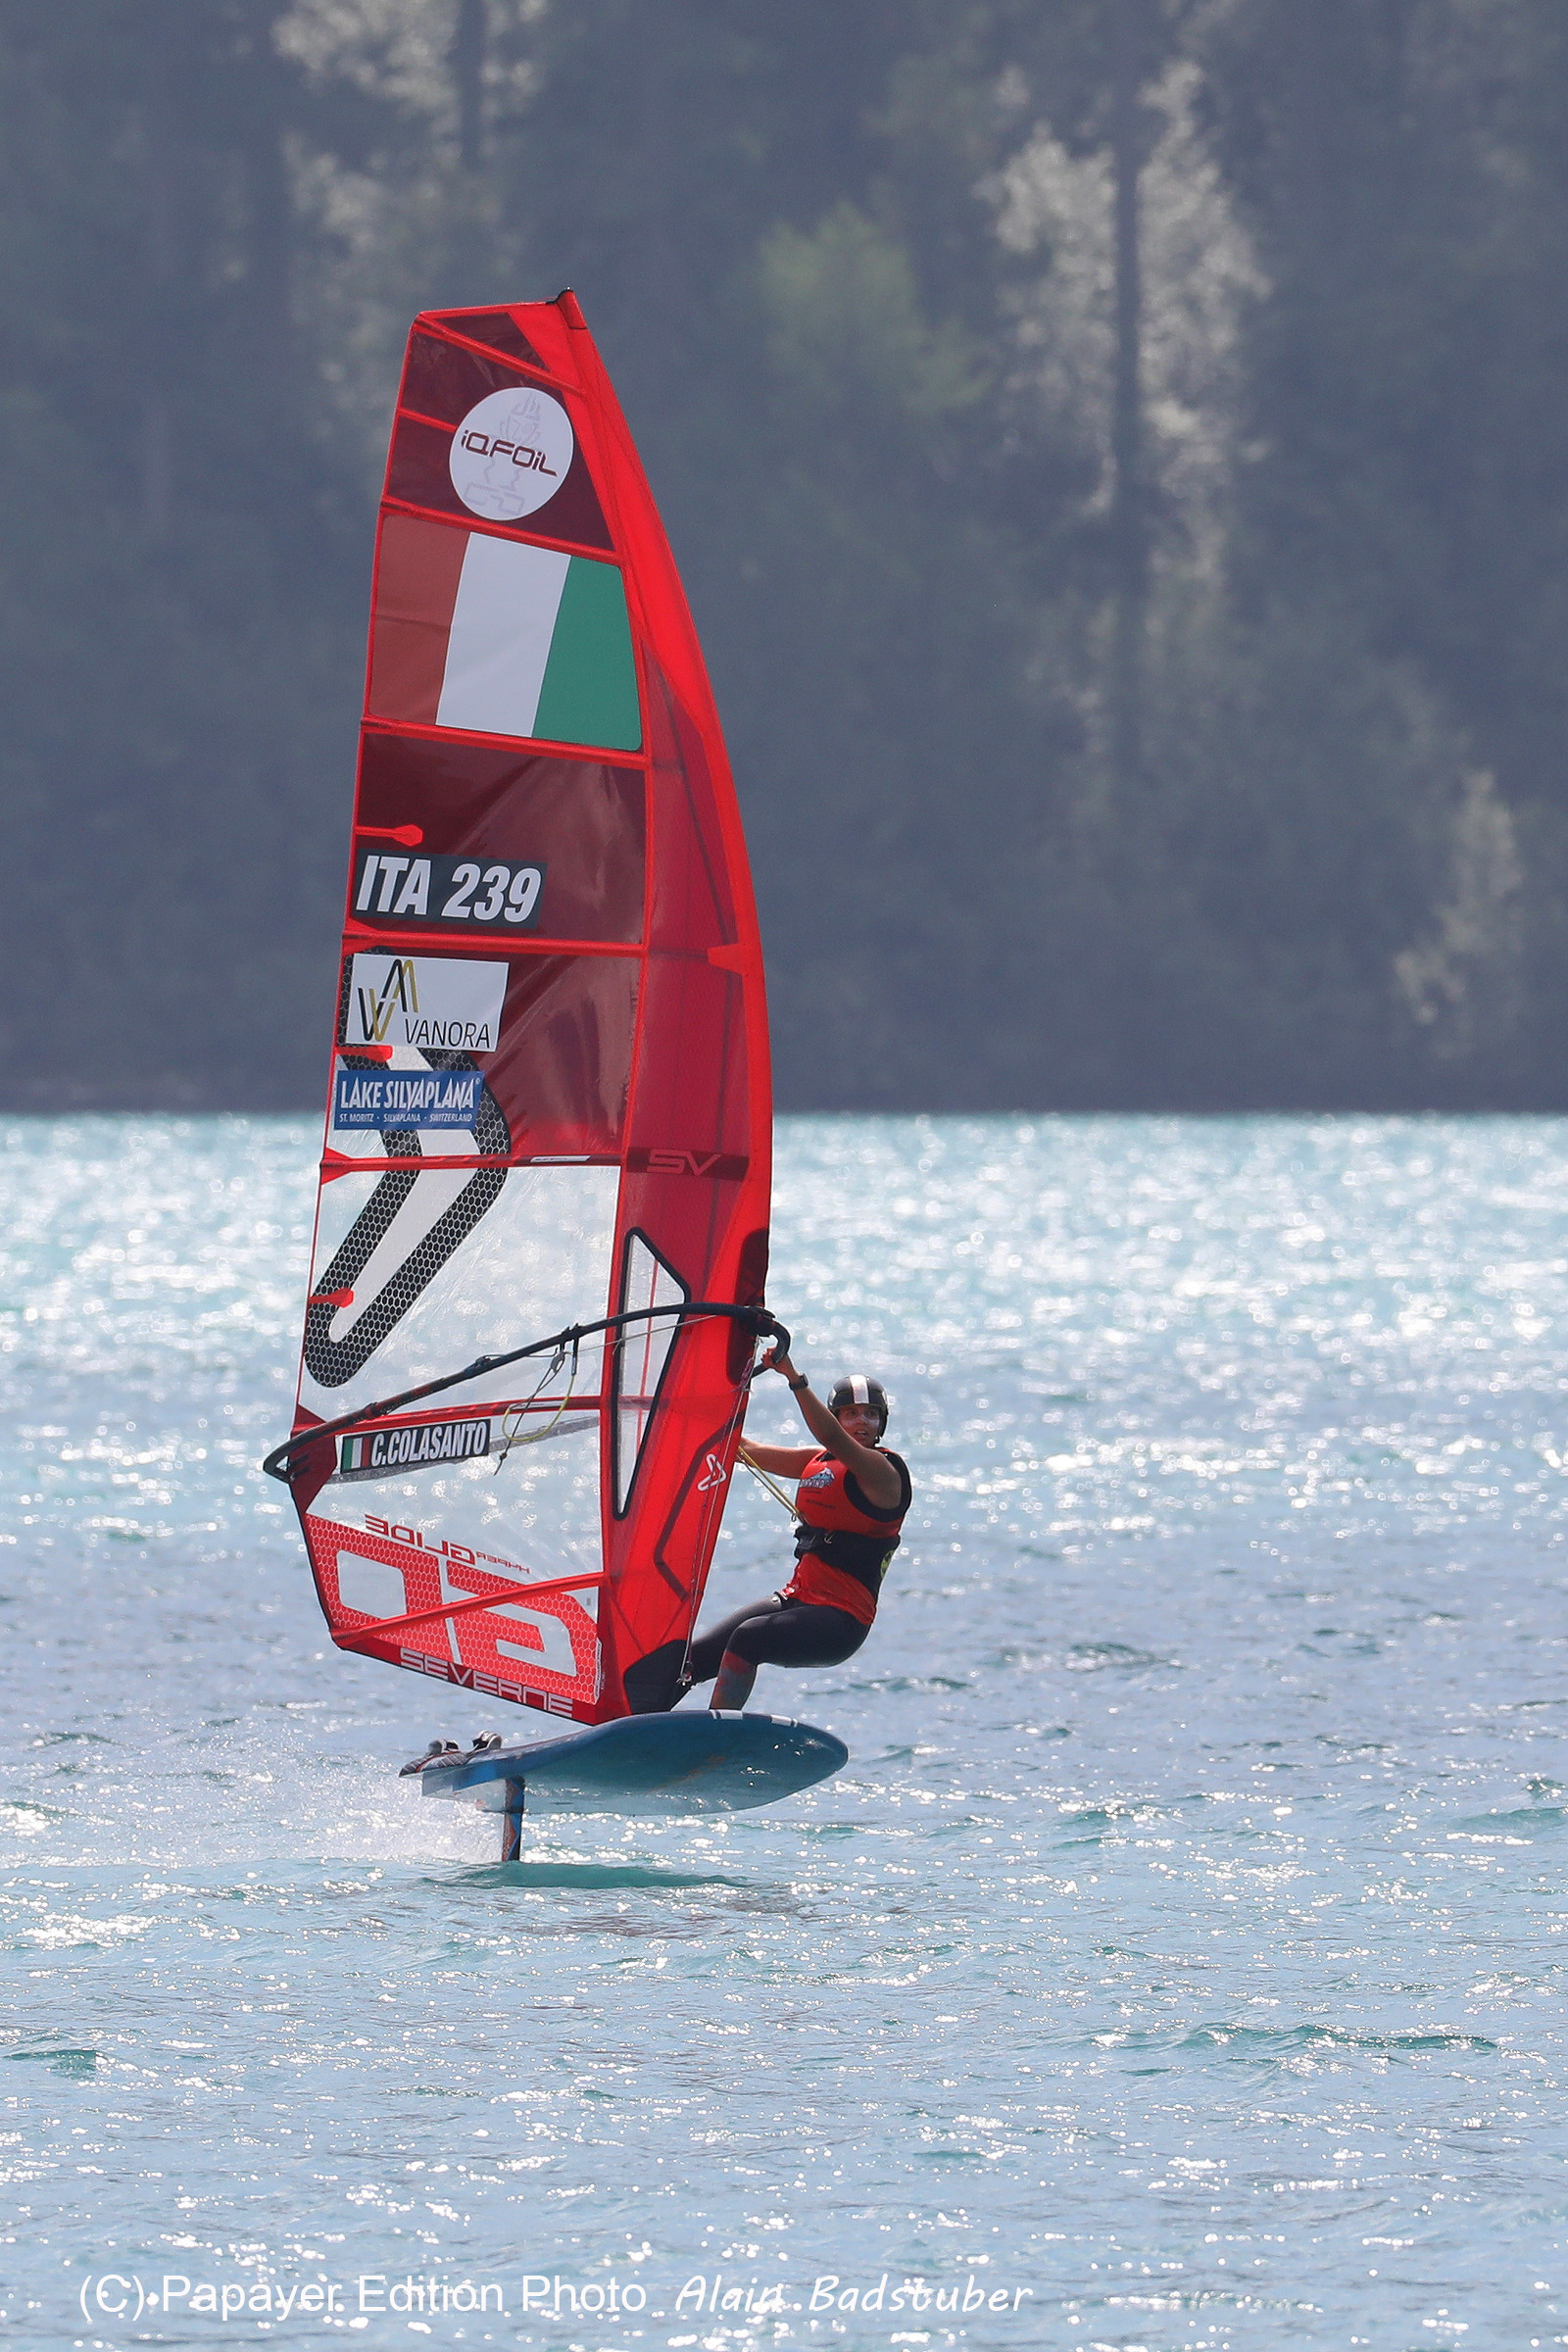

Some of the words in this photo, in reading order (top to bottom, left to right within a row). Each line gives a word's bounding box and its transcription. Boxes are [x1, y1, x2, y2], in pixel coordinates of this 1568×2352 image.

[356, 855, 432, 916] ITA
[441, 862, 542, 924] 239
[405, 1018, 491, 1049] VANORA
[340, 1077, 383, 1109] LAKE
[383, 1077, 474, 1111] SILVAPLANA
[349, 1113, 374, 1123] MORITZ
[383, 1113, 421, 1123] SILVAPLANA
[429, 1113, 472, 1123] SWITZERLAND
[370, 1421, 487, 1467] C.COLASANTO
[400, 1647, 573, 1717] SEVERNE
